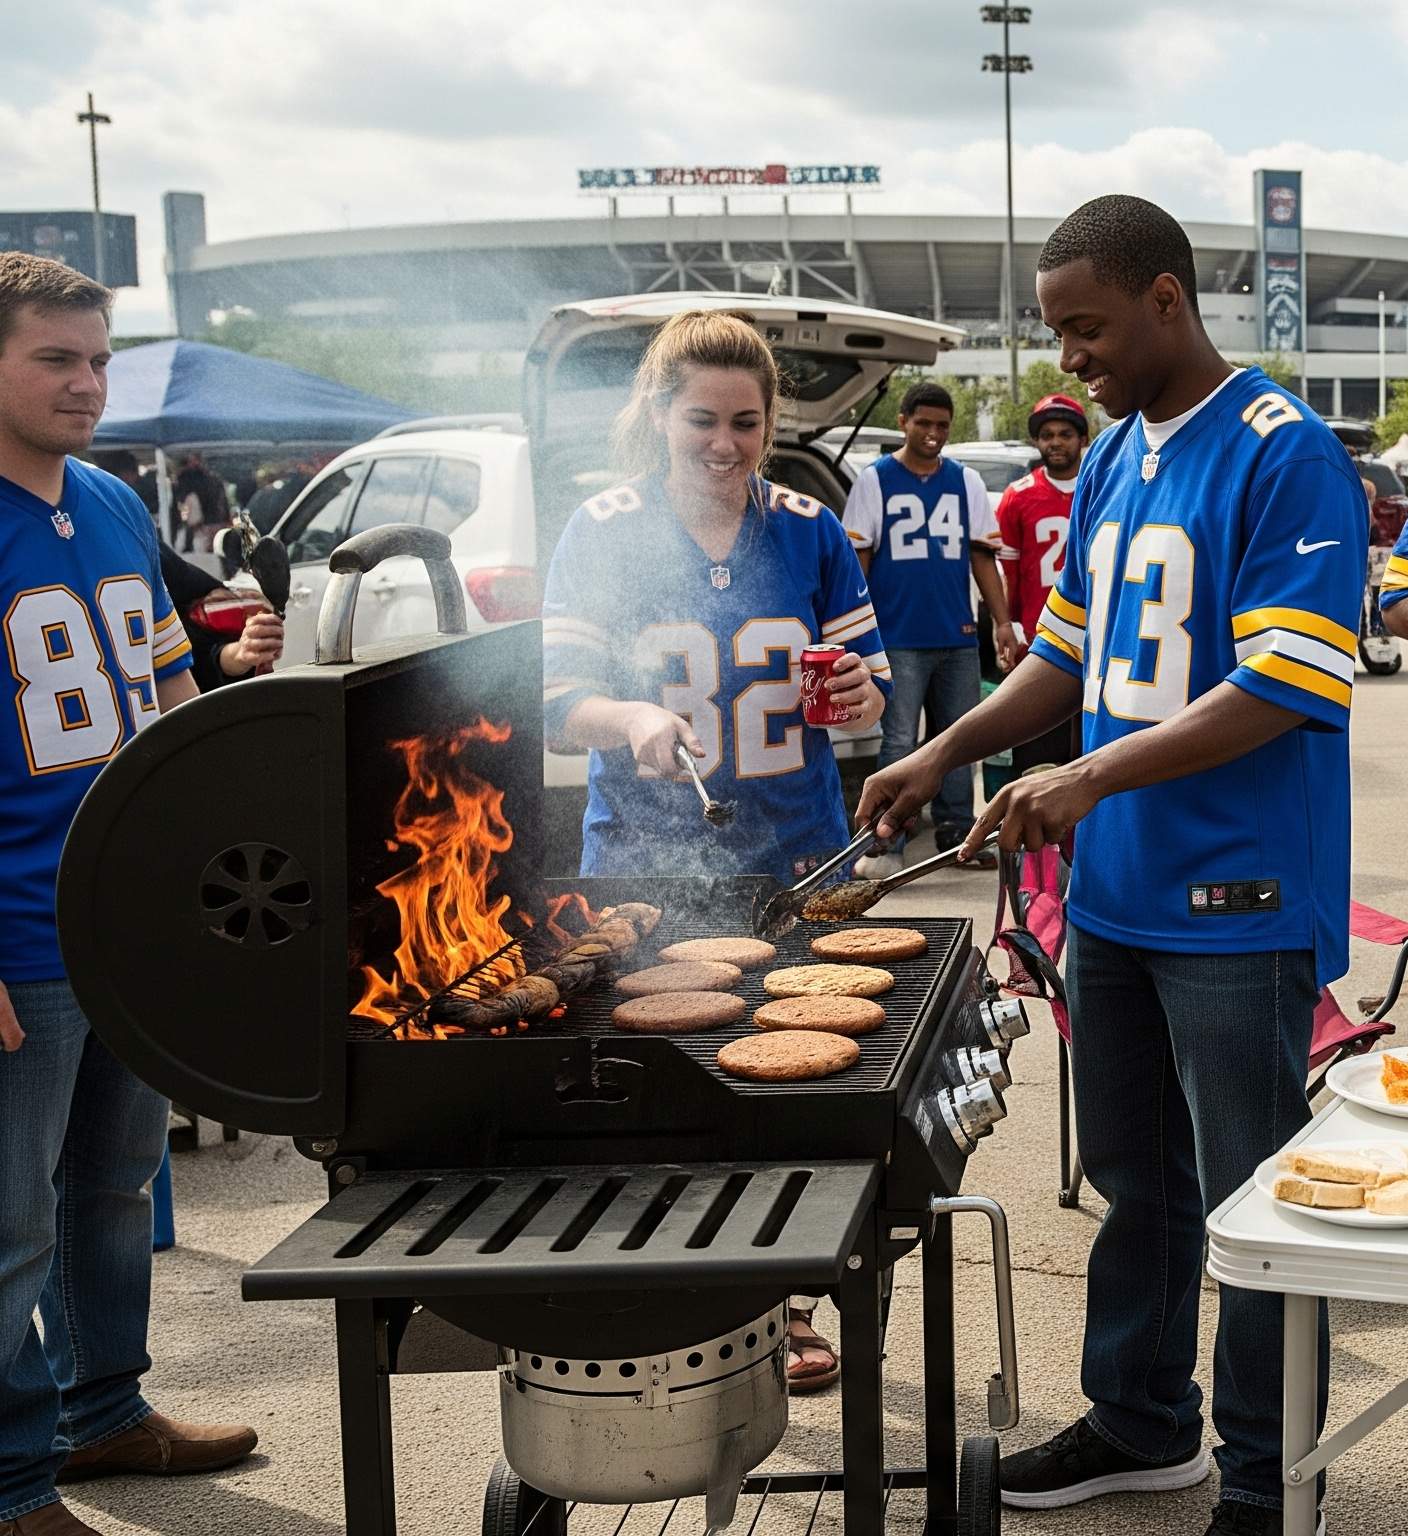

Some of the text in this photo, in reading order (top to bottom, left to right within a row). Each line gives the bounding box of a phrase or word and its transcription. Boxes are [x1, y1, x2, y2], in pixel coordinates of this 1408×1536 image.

[886, 493, 964, 561] 24
[1083, 522, 1195, 723] 13
[2, 573, 161, 777] 89
